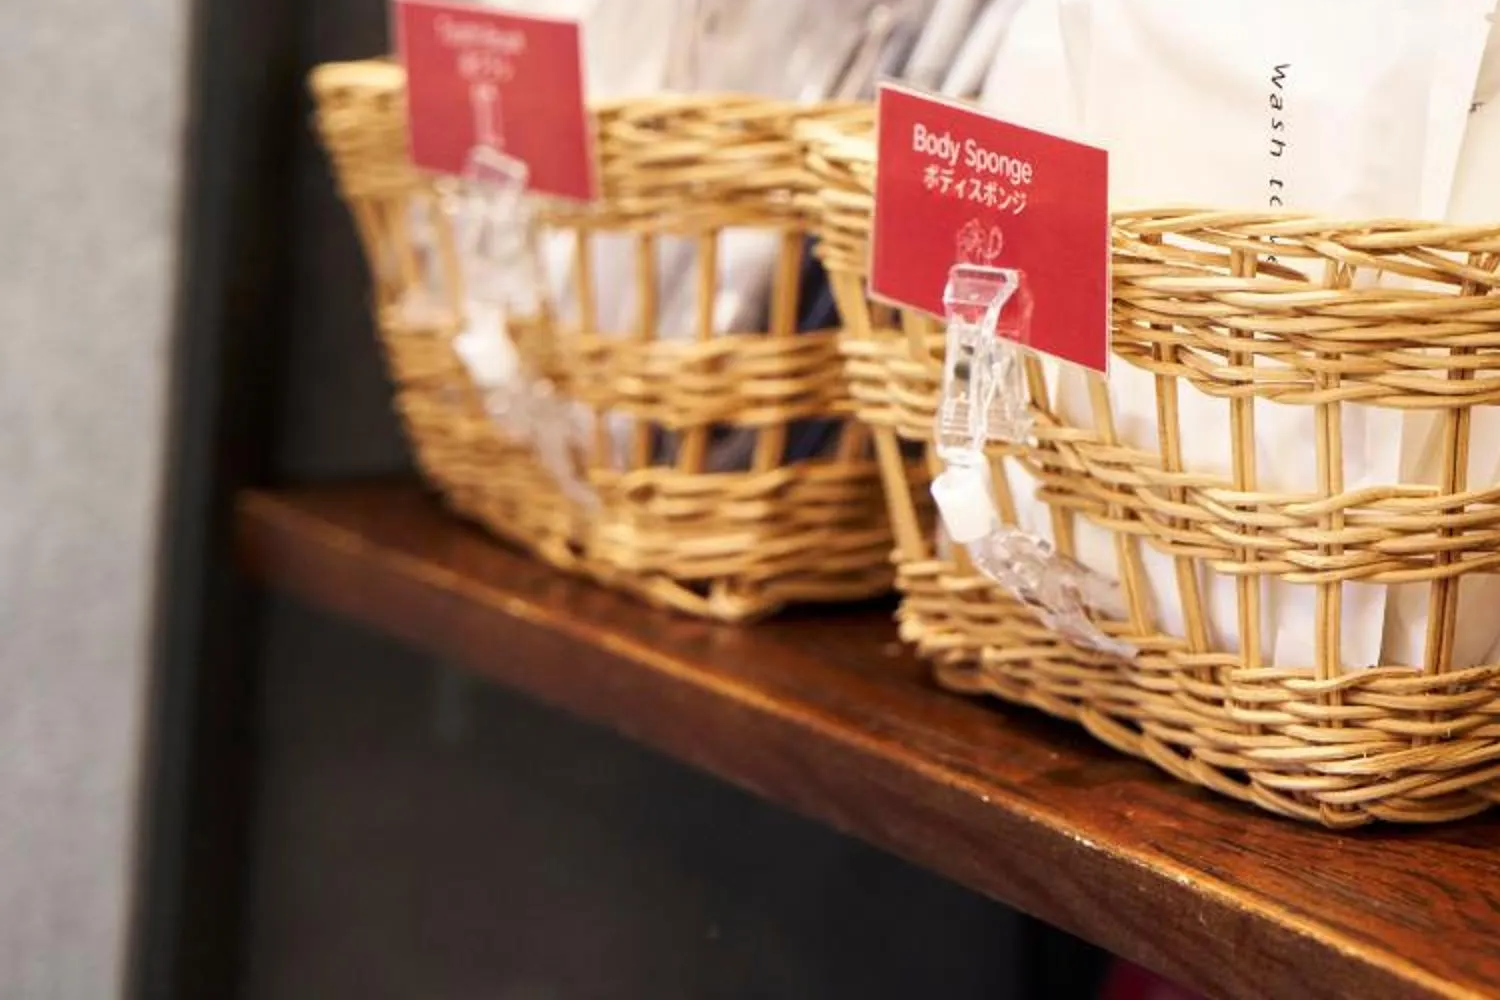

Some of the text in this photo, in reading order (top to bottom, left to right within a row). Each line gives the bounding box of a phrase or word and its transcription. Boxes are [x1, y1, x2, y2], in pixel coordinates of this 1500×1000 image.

[1268, 63, 1291, 157] wash
[912, 122, 1033, 185] Body Sponge
